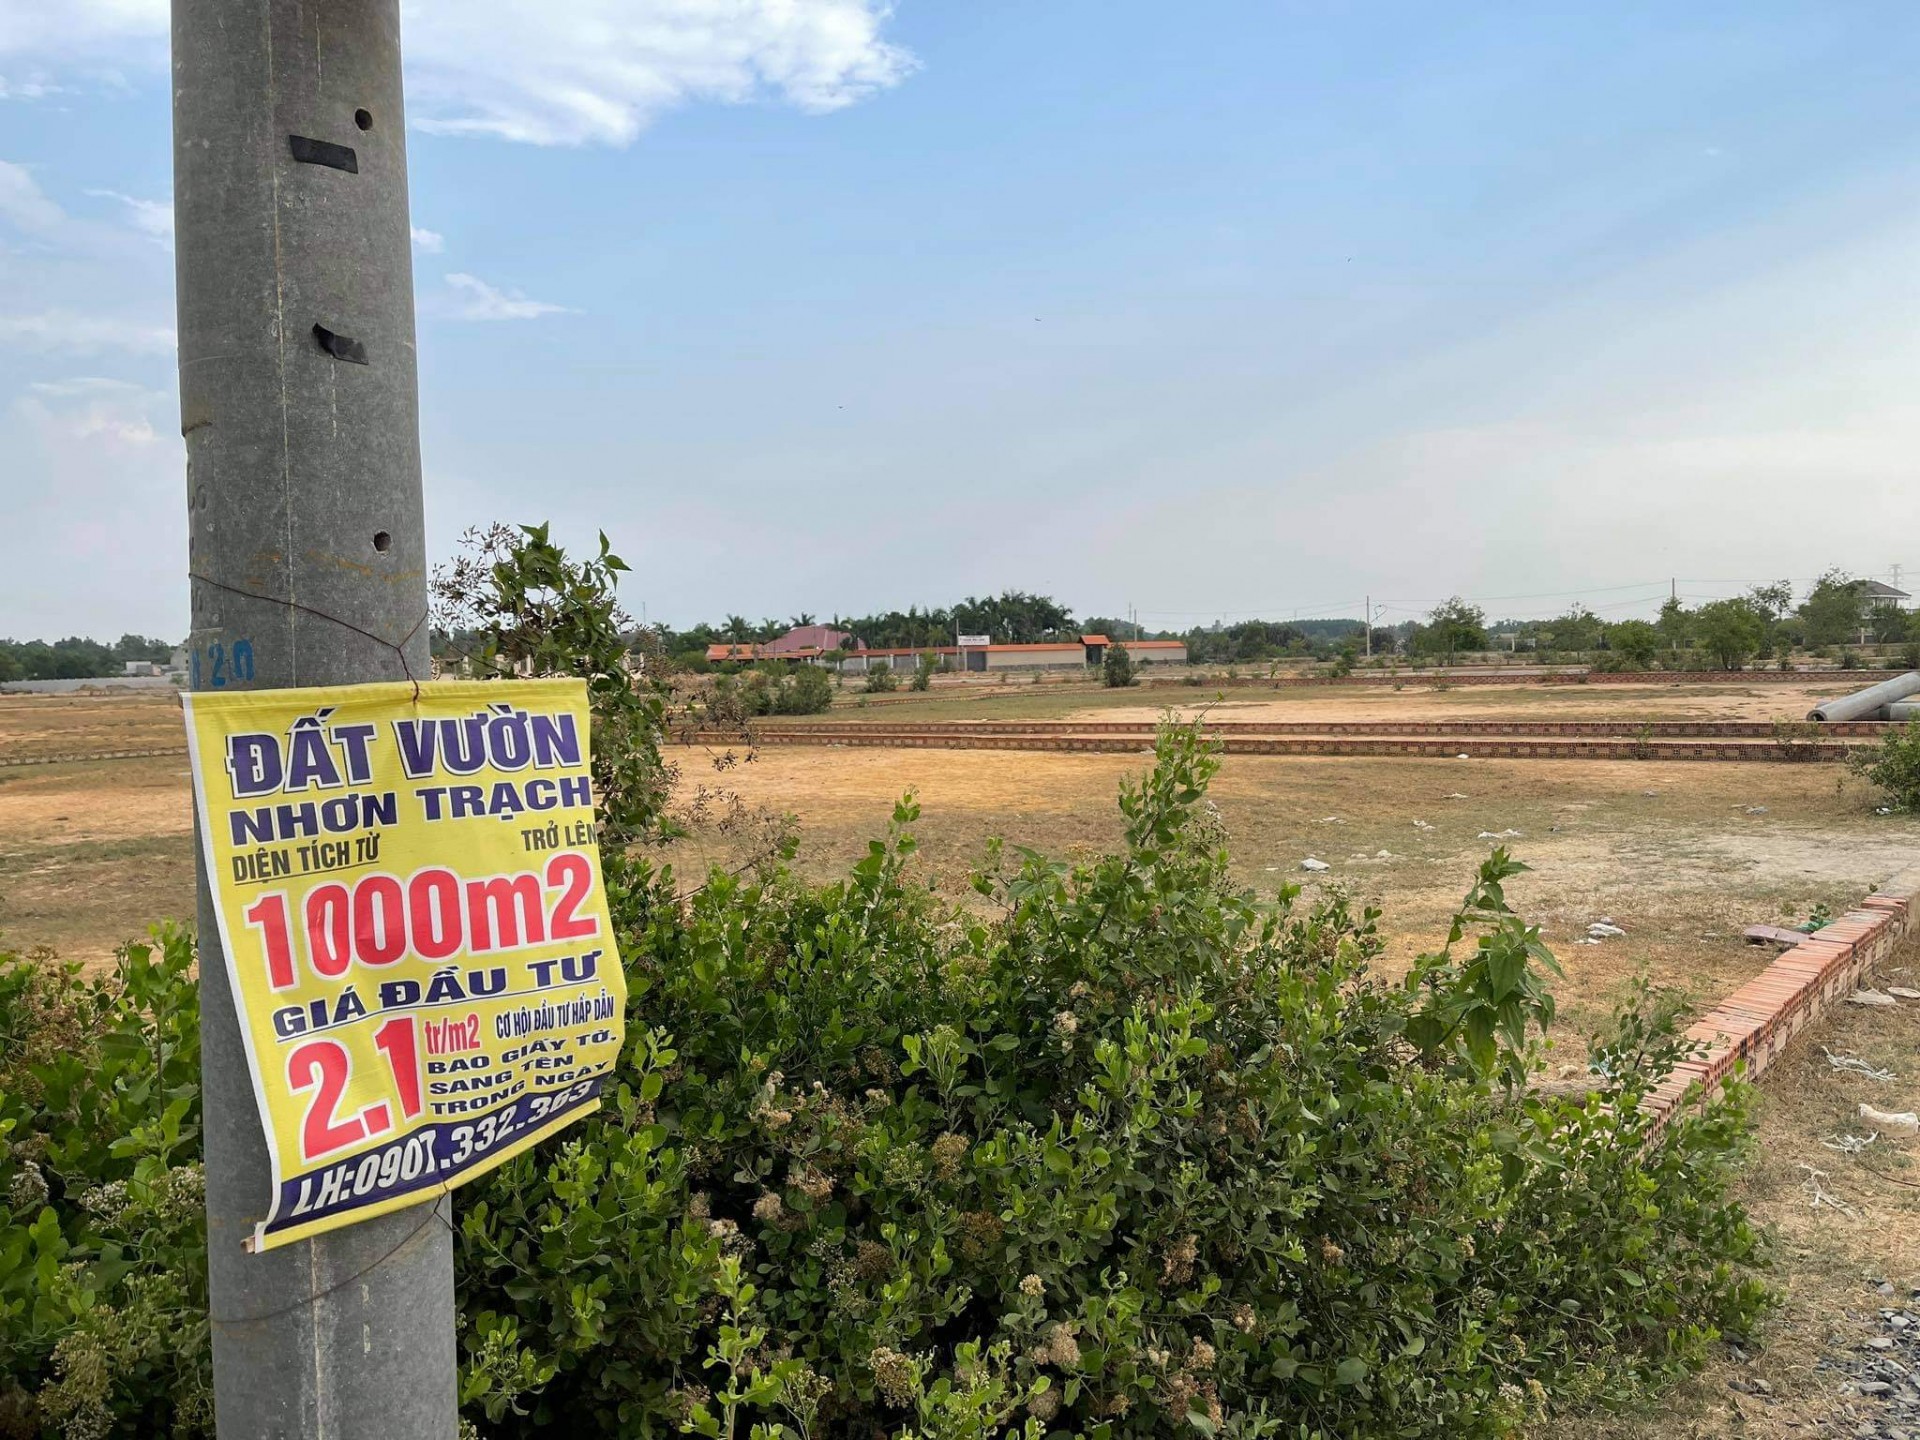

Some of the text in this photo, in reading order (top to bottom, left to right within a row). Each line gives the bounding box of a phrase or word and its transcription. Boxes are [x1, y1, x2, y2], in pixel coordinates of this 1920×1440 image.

[226, 703, 582, 799] ĐẤT VƯỜN
[229, 776, 591, 846] NHƠN TRẠCH
[521, 820, 598, 851] TRỞ LÊN
[232, 832, 381, 884] DIỆN TÍCH TỪ
[248, 853, 599, 991] 1000m2
[273, 950, 602, 1037] GIÁ ĐẦU TƯ
[496, 1013, 511, 1039] CƠ
[514, 1006, 531, 1038] HỘI
[534, 999, 554, 1031] ĐẦU
[556, 1001, 570, 1027] TƯ
[572, 992, 592, 1025] HẤP
[424, 1013, 481, 1054] tr/m2
[427, 1055, 490, 1074] BAO
[502, 1037, 566, 1064] GIẤY
[288, 1017, 422, 1160] 2.1
[429, 1054, 574, 1095] SANG TÊN
[430, 1060, 609, 1115] TRONG NGÀY
[290, 1080, 592, 1217] LH:0907.332.363
